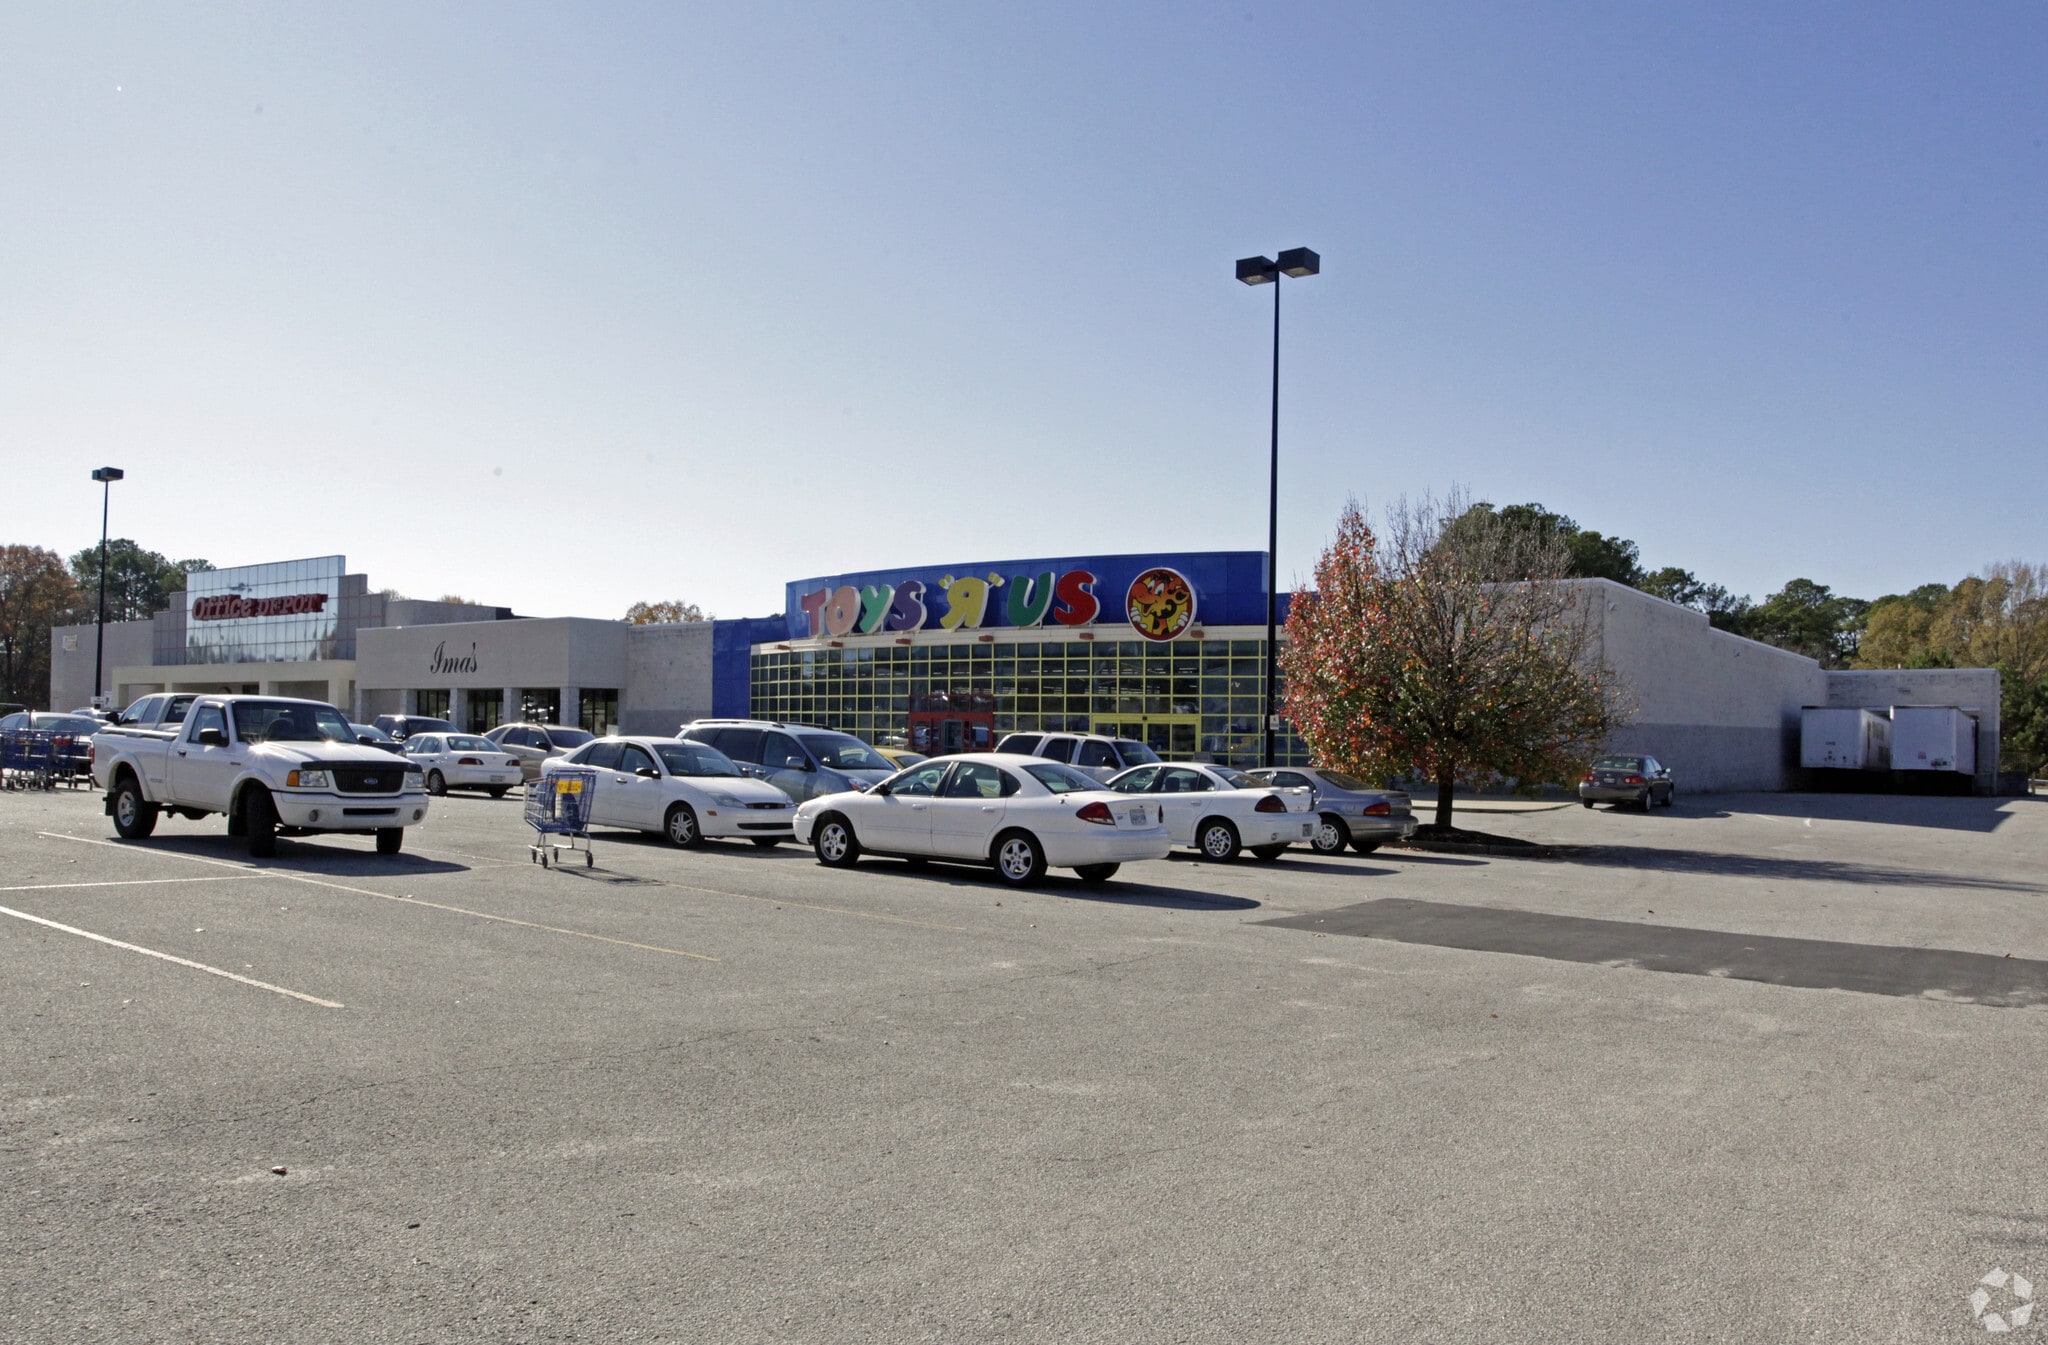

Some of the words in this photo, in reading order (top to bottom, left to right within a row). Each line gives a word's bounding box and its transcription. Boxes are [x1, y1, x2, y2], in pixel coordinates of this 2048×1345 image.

[192, 594, 253, 621] Office
[255, 594, 326, 617] DEPOT
[801, 580, 927, 636] TOYS
[1007, 570, 1100, 627] US
[430, 640, 478, 674] Ima's
